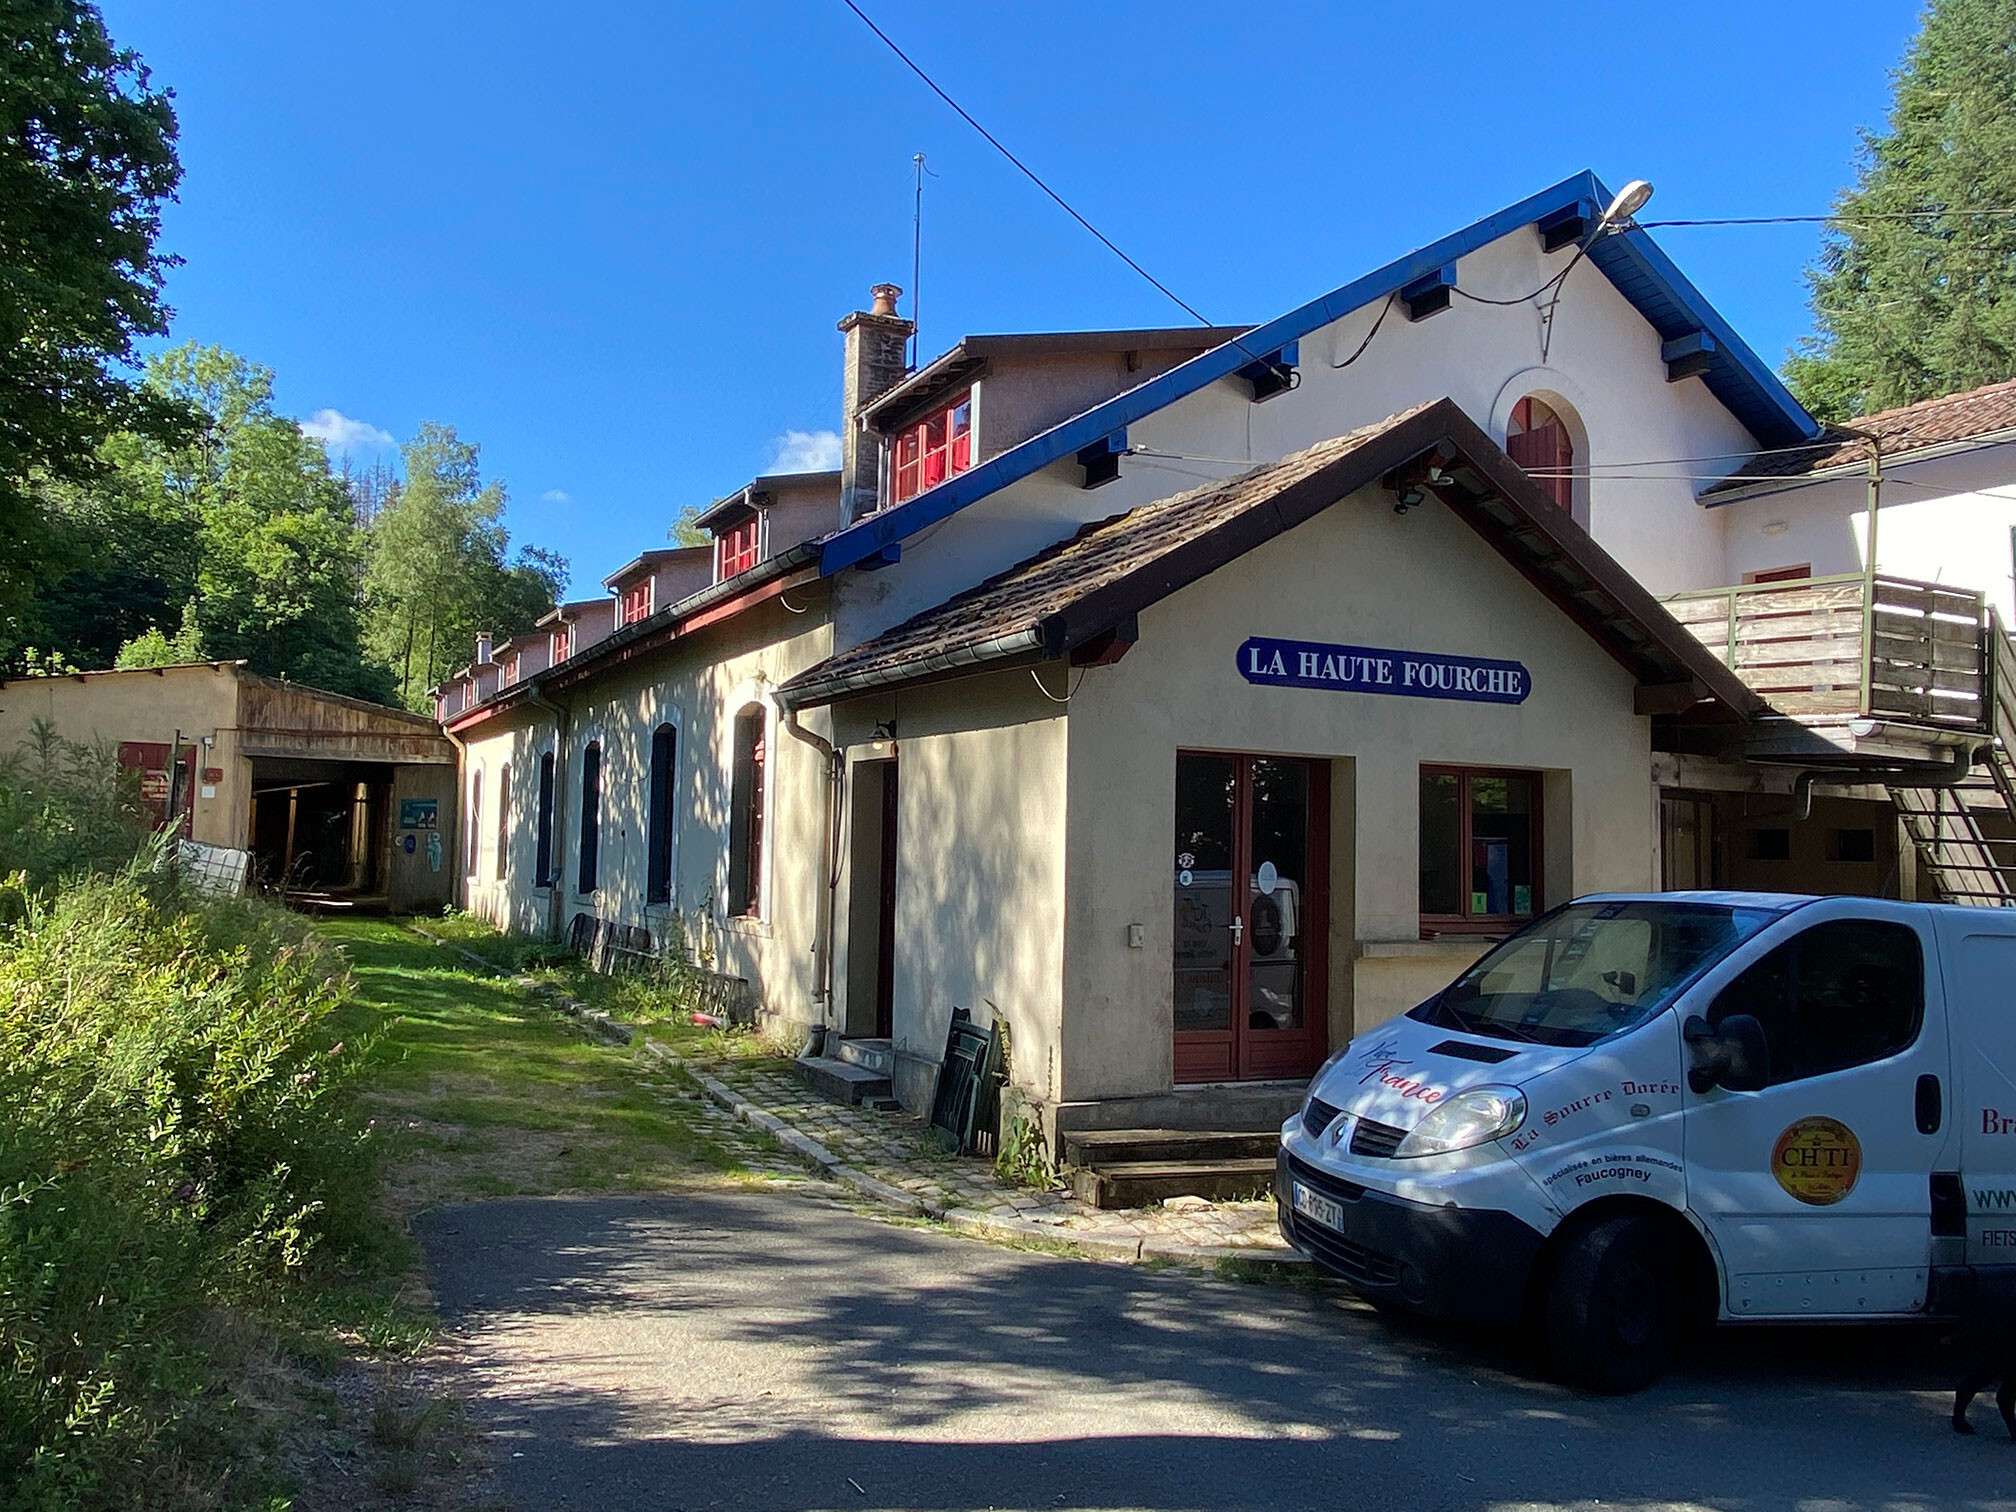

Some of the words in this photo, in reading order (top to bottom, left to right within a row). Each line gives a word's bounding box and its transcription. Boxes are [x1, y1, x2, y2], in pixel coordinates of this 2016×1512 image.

[1249, 647, 1287, 676] LA
[1297, 651, 1393, 684] HAUTE
[1402, 661, 1522, 695] FOURCHE
[1359, 1059, 1441, 1104] France
[1510, 1129, 1540, 1151] La
[1543, 1090, 1612, 1126] Source
[1621, 1080, 1680, 1096] Dorée
[1981, 1108, 2016, 1134] Br
[1575, 1167, 1651, 1187] Faucogney
[1591, 1156, 1602, 1165] en
[1604, 1153, 1632, 1162] bières
[1635, 1154, 1683, 1172] allemandes
